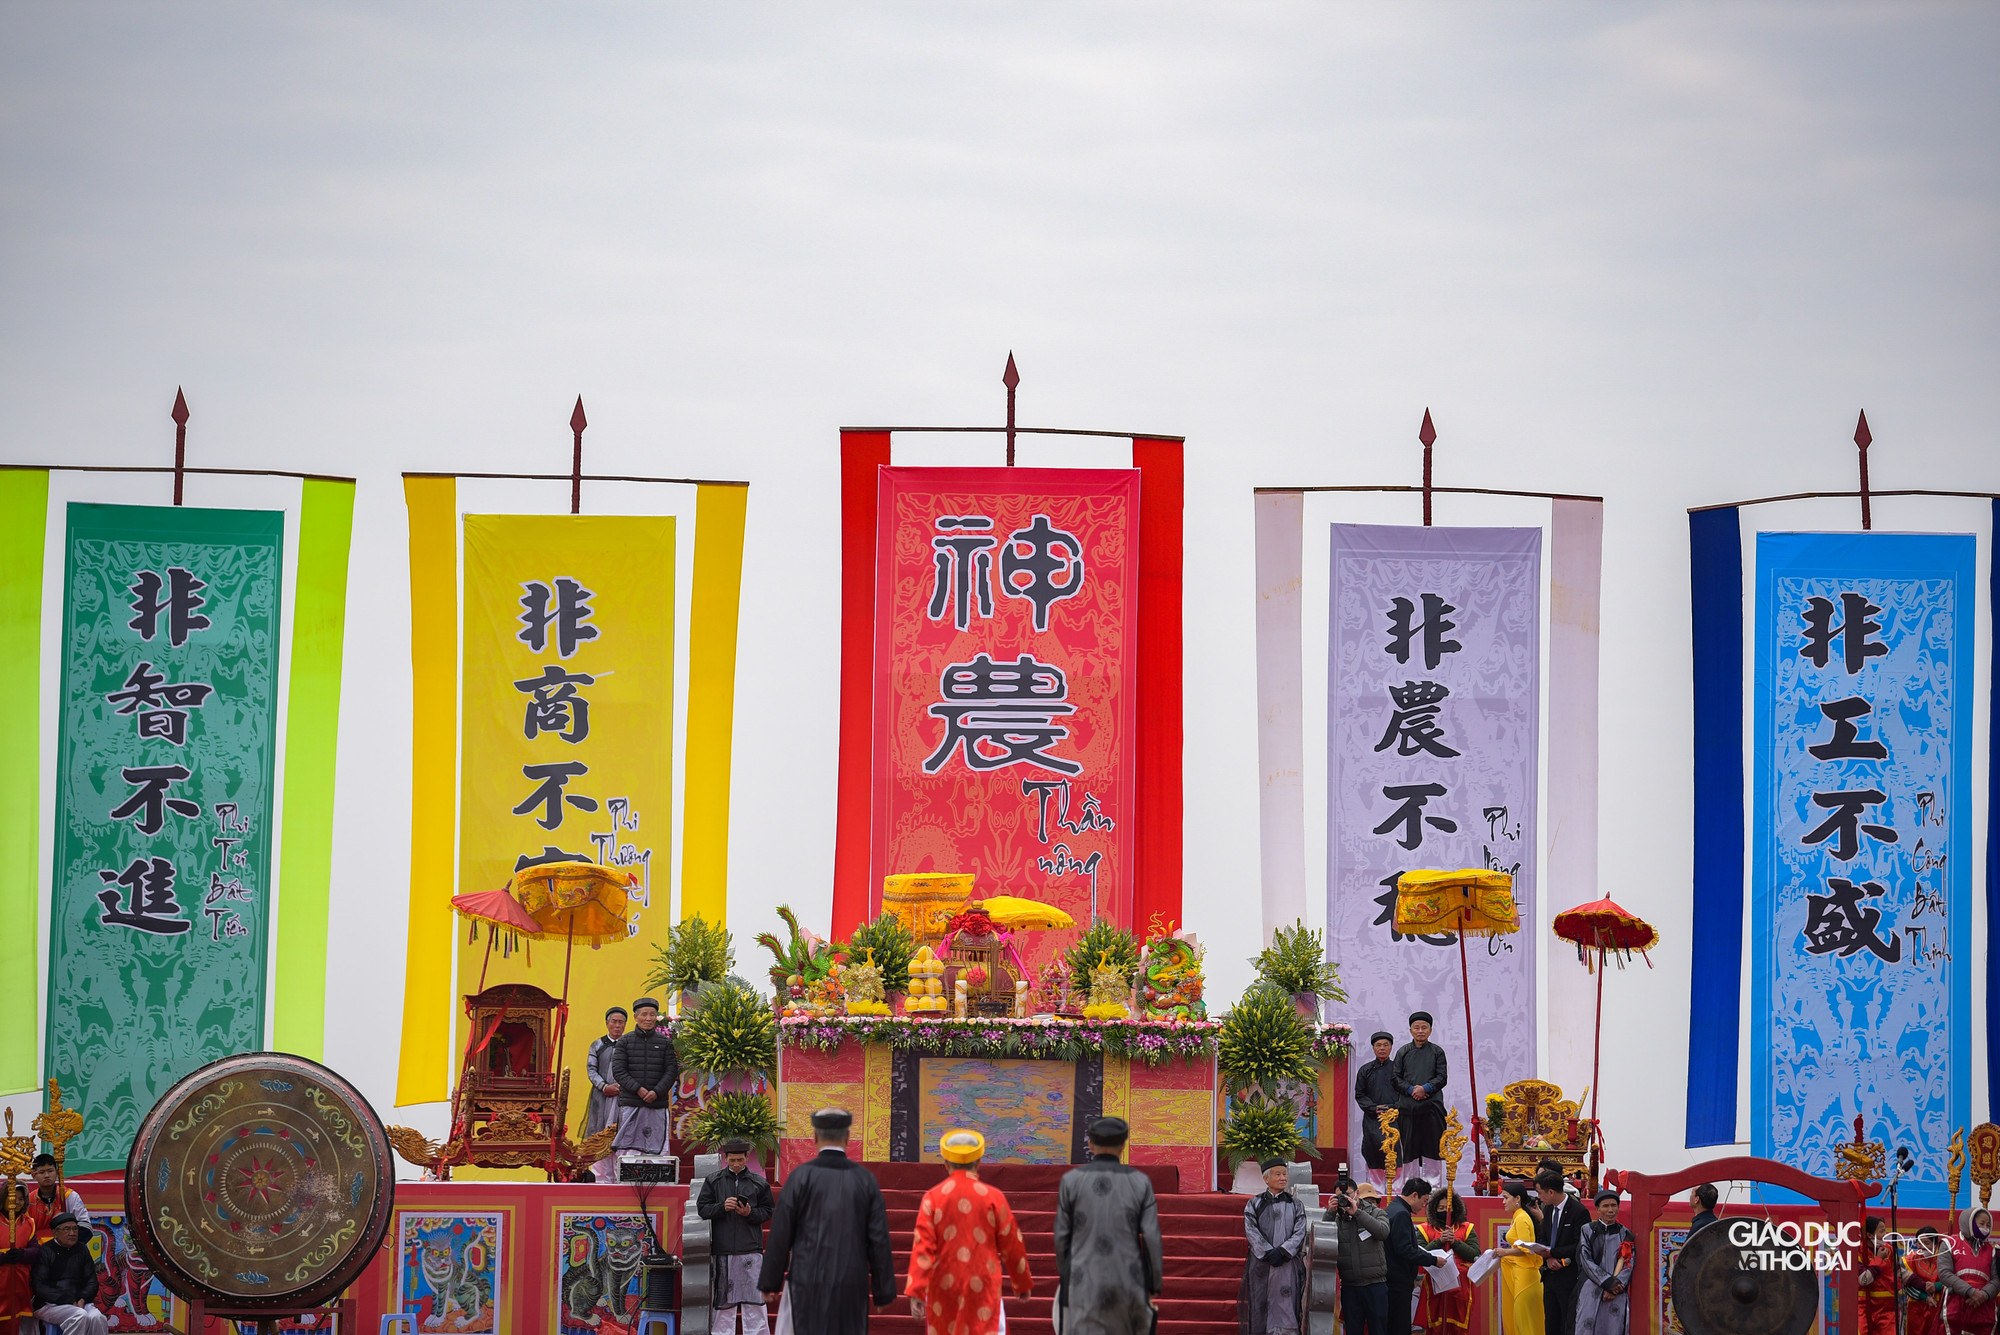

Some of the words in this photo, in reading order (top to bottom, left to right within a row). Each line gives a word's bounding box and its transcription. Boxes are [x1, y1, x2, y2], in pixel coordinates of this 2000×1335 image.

[922, 514, 1085, 775] 神農
[512, 576, 601, 875] 非商不
[98, 567, 212, 934] 非智不進
[1800, 593, 1901, 964] 非工不盛
[214, 802, 249, 833] Phi
[607, 797, 640, 831] Phi
[1022, 778, 1115, 843] Thần
[1483, 806, 1521, 842] Phi
[1916, 792, 1944, 827] Phi
[213, 838, 248, 870] Trí
[205, 872, 253, 905] Bất
[1037, 843, 1102, 926] nông
[1911, 881, 1947, 919] Bất
[204, 907, 248, 941] Tiến
[1905, 925, 1952, 969] Thịnh
